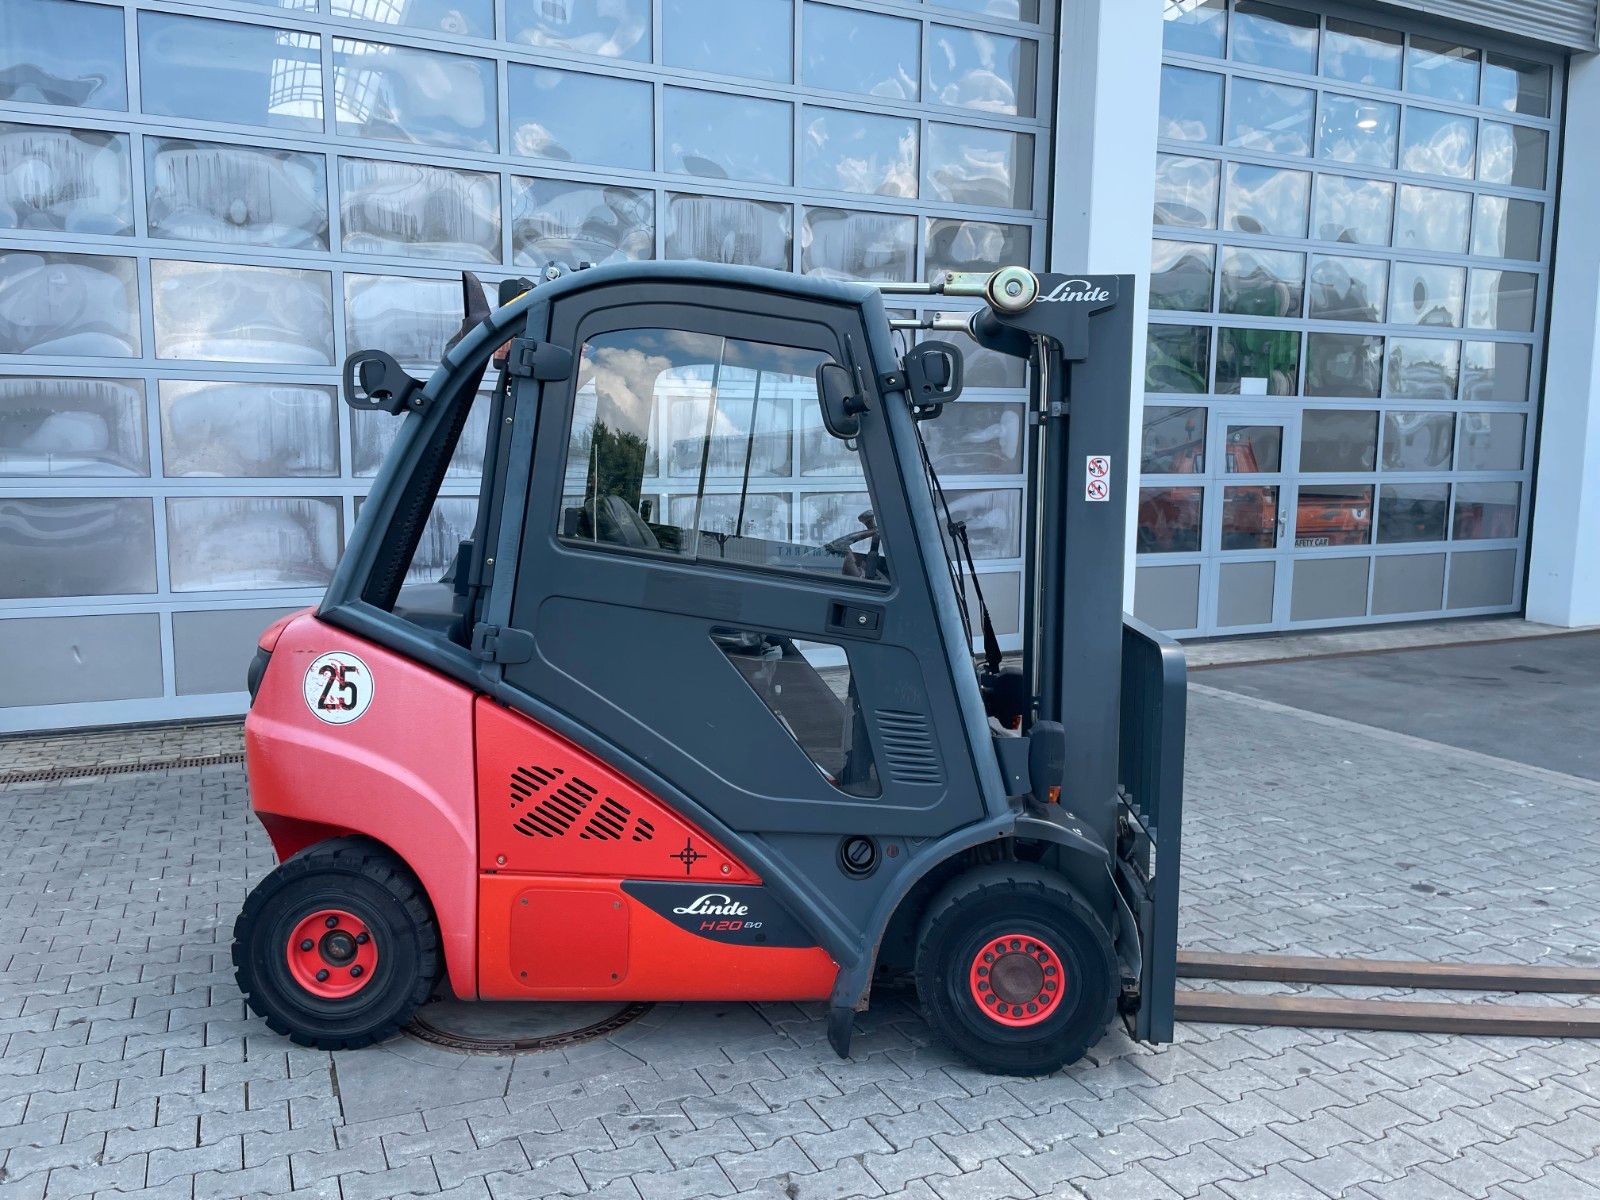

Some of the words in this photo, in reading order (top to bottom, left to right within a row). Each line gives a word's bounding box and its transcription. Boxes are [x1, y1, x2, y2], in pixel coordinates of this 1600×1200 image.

[1036, 279, 1110, 303] Linde
[1294, 539, 1313, 547] AFETY
[317, 664, 358, 711] 25
[672, 893, 749, 916] Linde
[699, 920, 743, 931] H20
